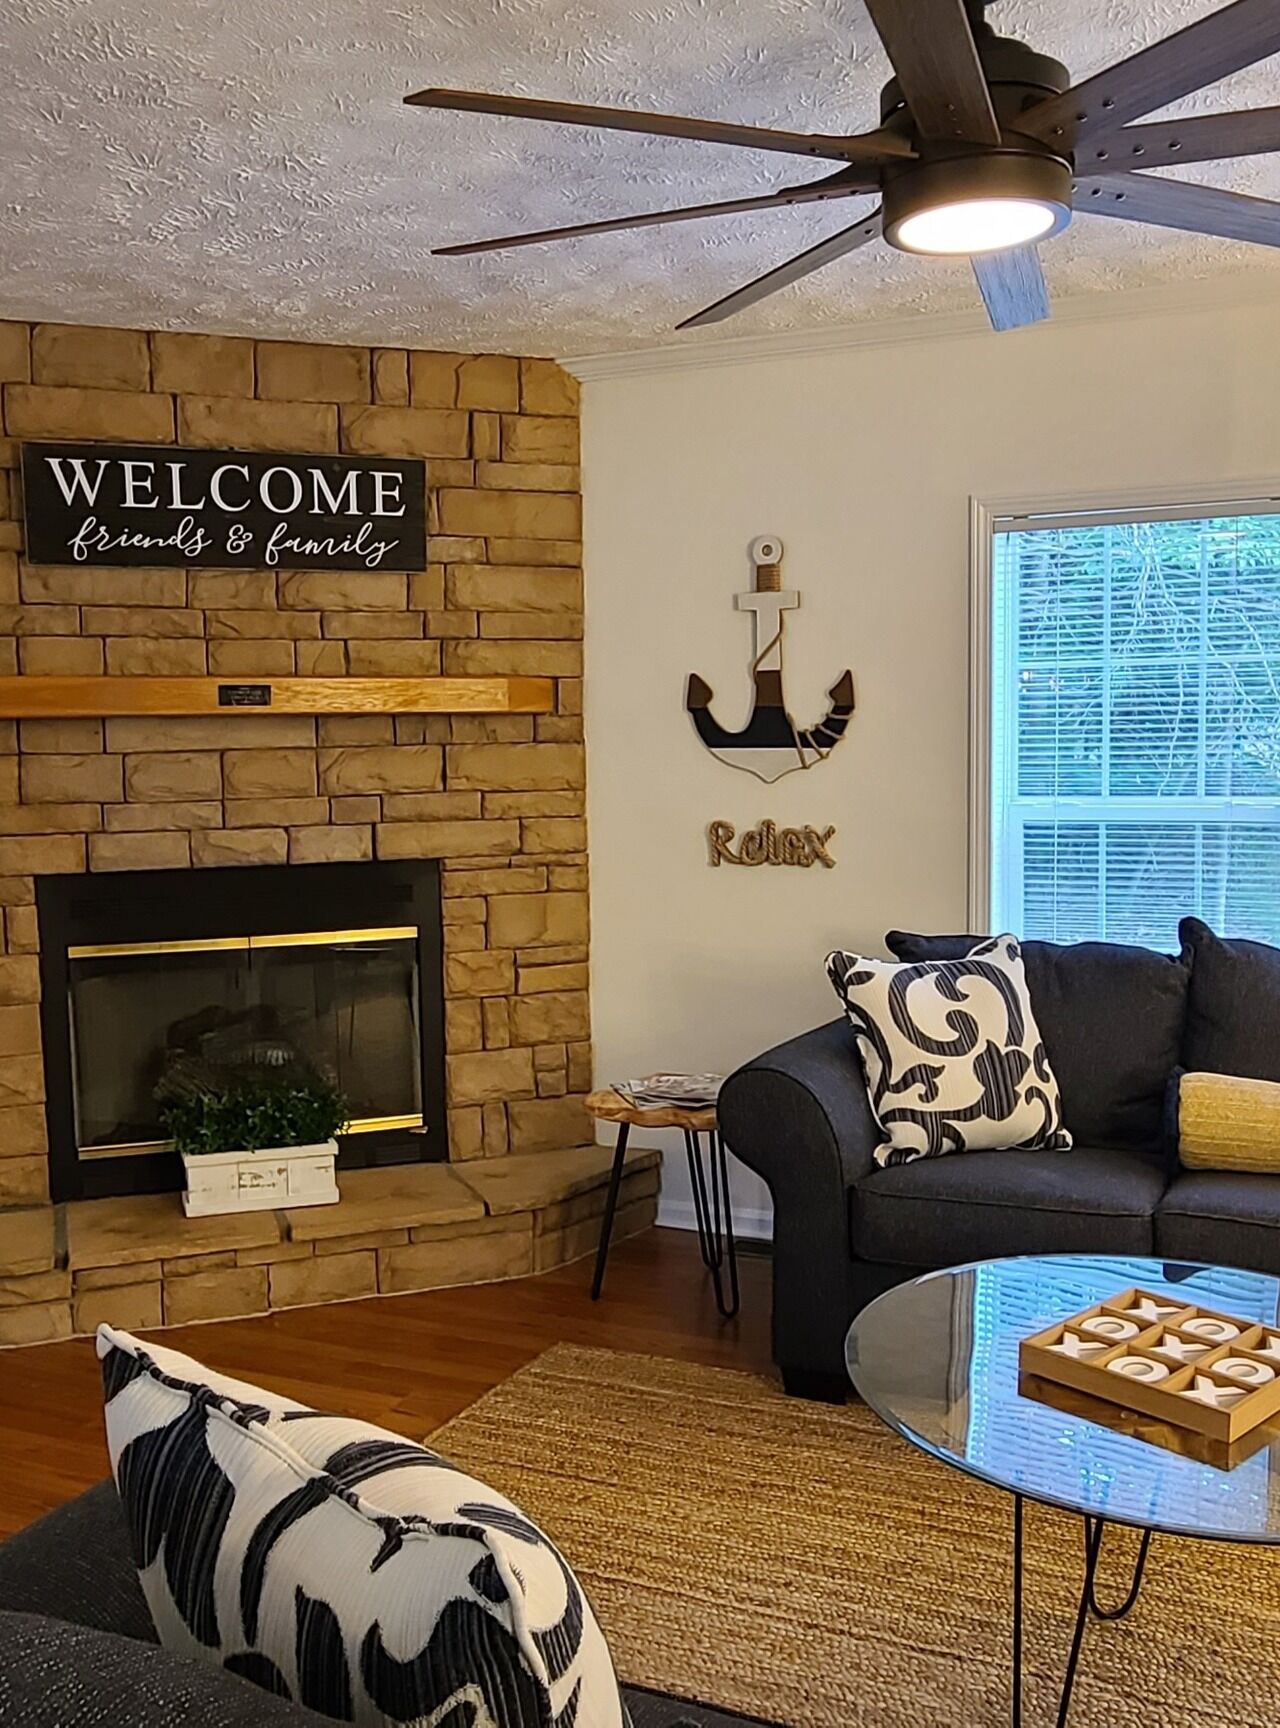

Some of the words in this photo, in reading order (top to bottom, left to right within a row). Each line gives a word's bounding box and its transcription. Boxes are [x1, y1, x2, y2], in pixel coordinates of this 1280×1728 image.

[43, 456, 407, 517] WELCOME
[67, 516, 214, 561] friends
[226, 524, 254, 554] &
[265, 521, 400, 568] family
[708, 818, 837, 869] Relax
